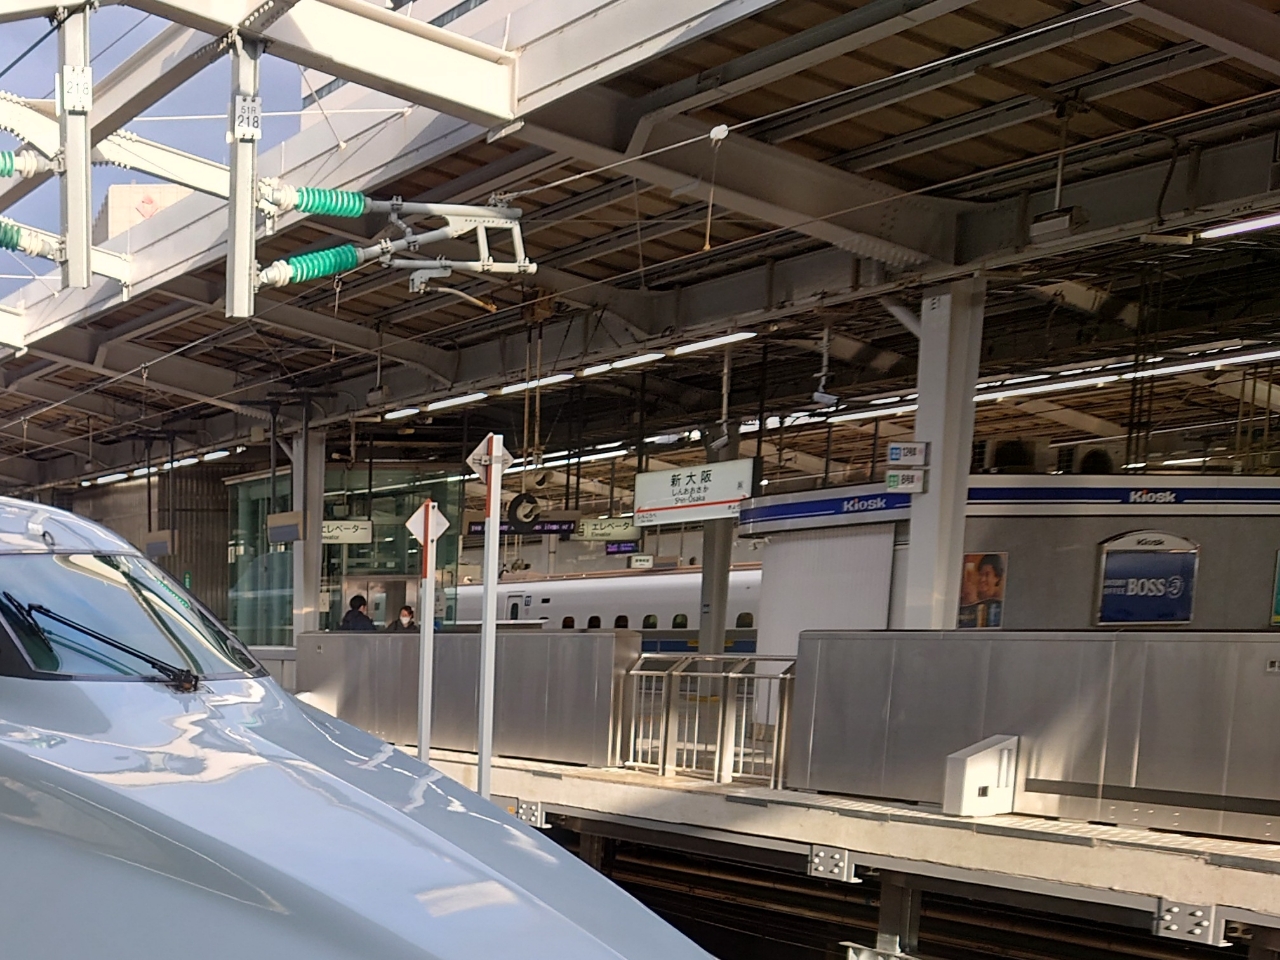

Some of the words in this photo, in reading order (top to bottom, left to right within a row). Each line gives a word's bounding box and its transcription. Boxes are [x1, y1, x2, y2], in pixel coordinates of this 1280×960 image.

[66, 81, 89, 95] 218
[237, 115, 260, 129] 218
[670, 469, 713, 488] 新大阪
[671, 485, 709, 497] しんおおさか
[1126, 489, 1177, 503] Kiosk
[843, 497, 887, 512] Kiosk
[592, 522, 634, 531] エレベータ
[1137, 538, 1165, 546] Kiosk
[1126, 578, 1166, 596] BOSS
